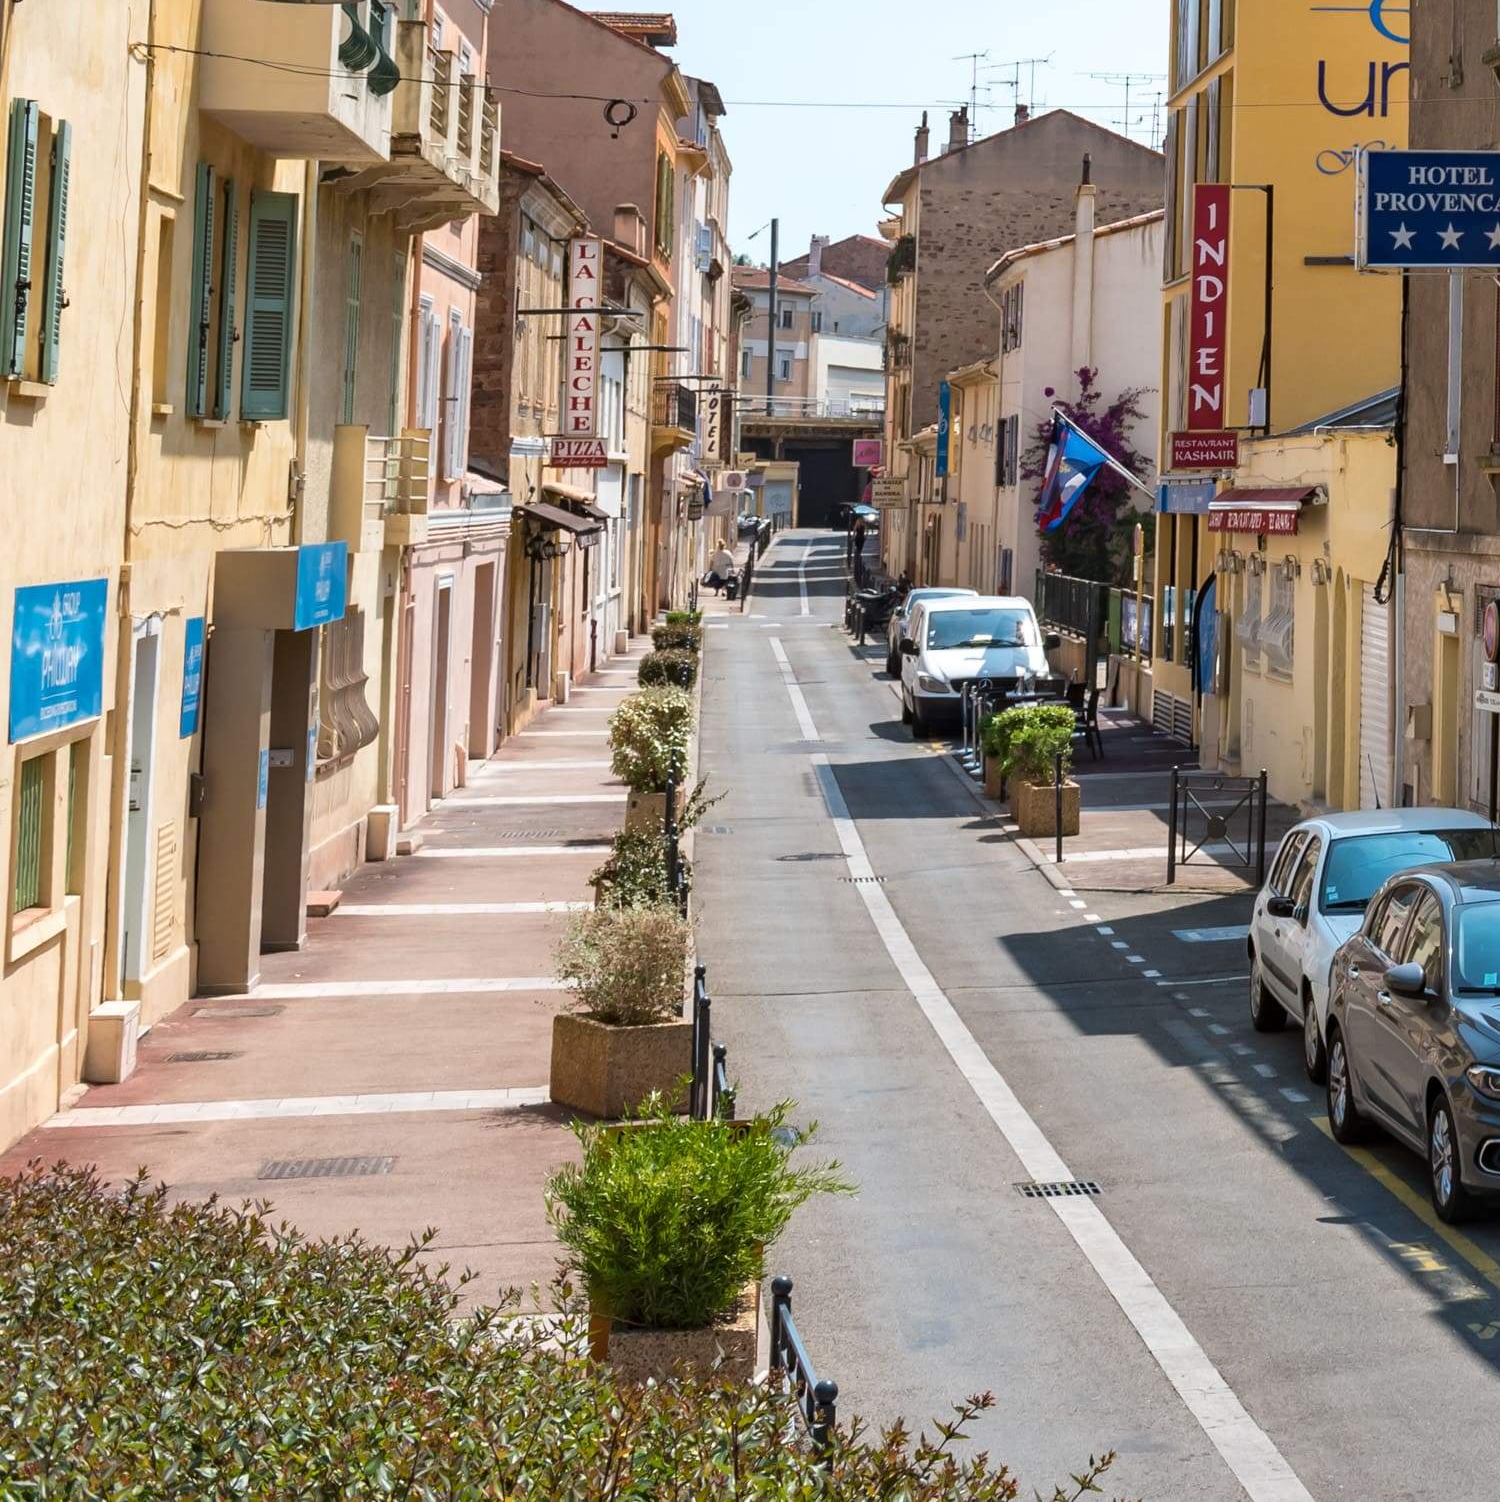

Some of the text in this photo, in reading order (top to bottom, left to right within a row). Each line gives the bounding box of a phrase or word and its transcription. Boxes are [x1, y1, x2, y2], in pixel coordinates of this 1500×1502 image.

[1408, 166, 1494, 186] HOTEL
[1190, 202, 1226, 412] INDIEN
[569, 244, 596, 432] LA CALECHE
[707, 383, 719, 453] HOTEL
[554, 441, 606, 456] PIZZA
[1175, 439, 1235, 447] RESTAURANT
[1175, 450, 1236, 461] KASHMIR
